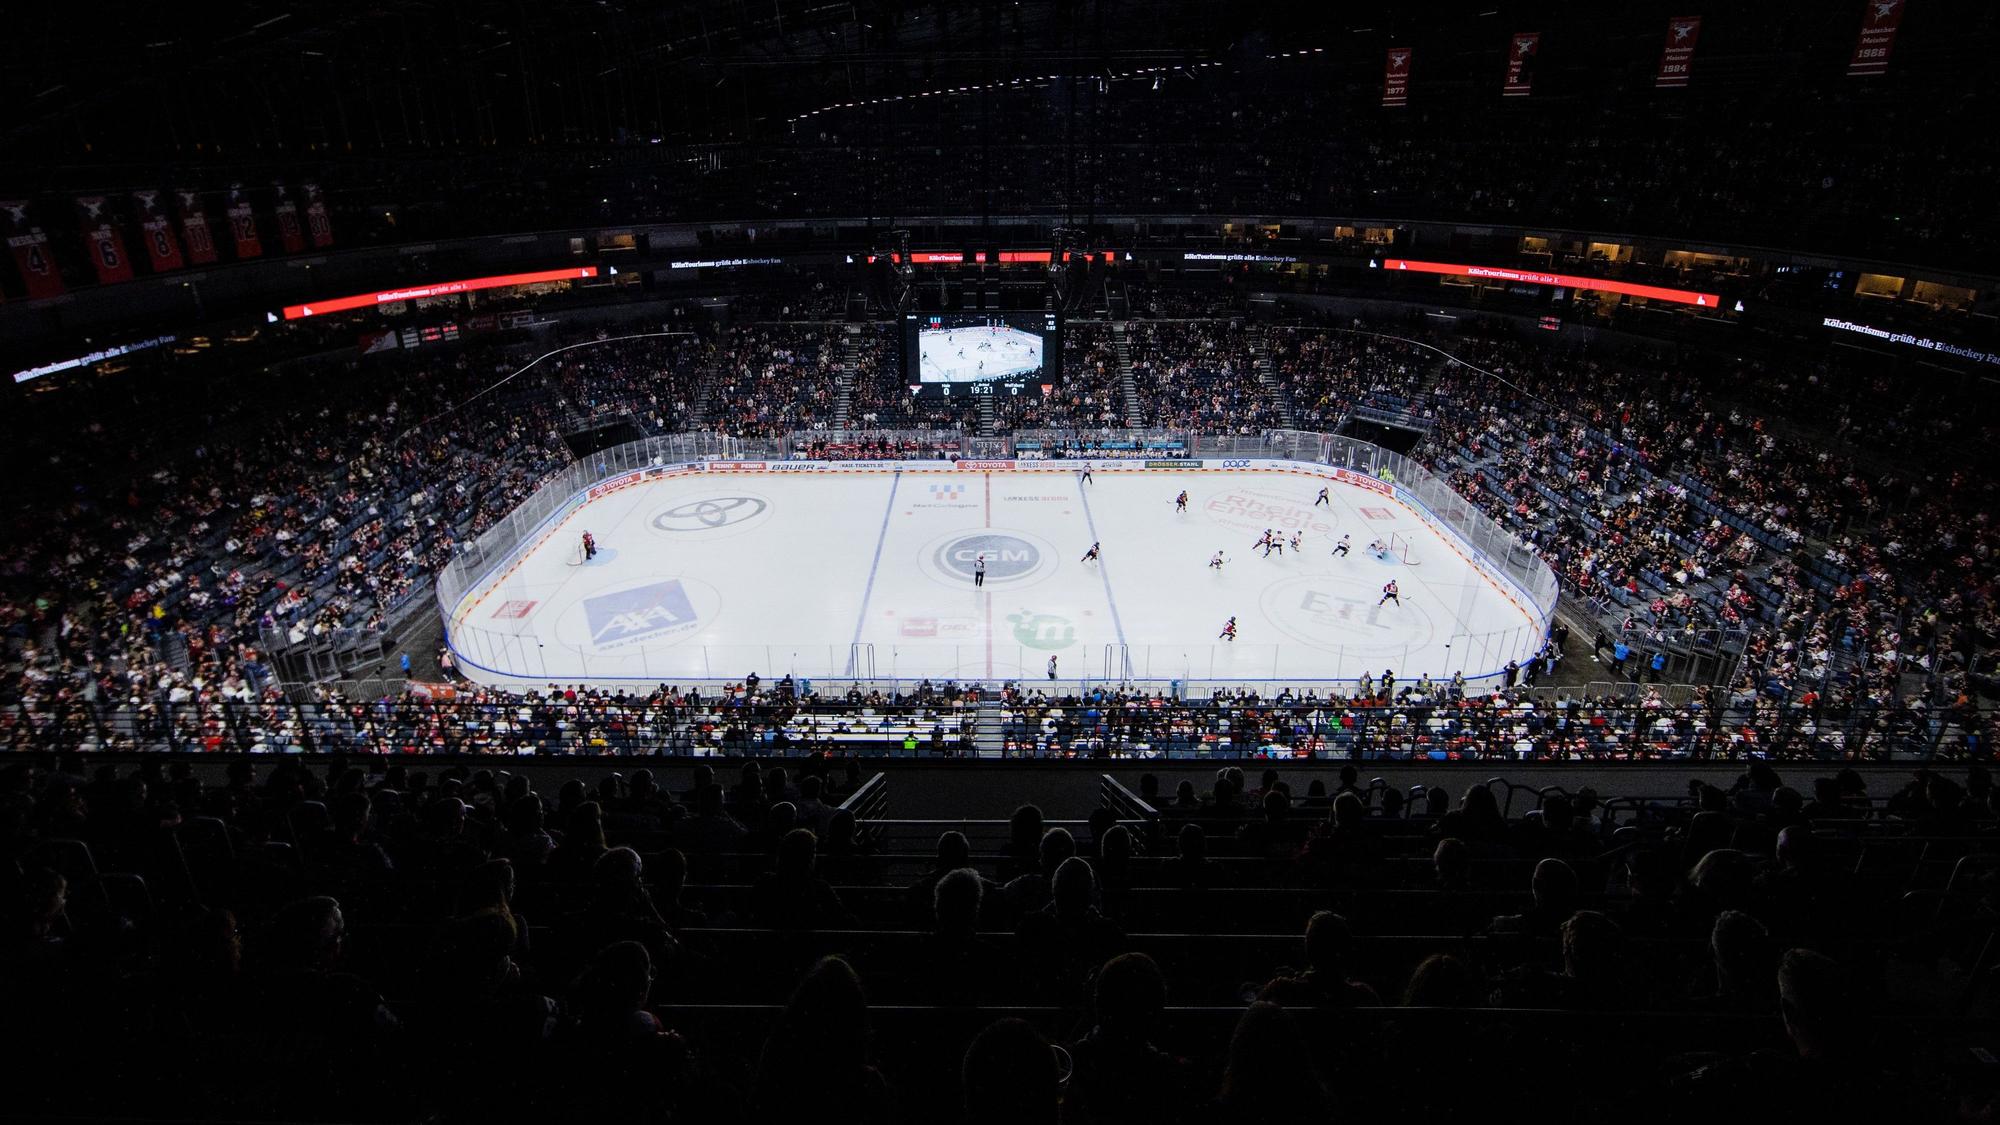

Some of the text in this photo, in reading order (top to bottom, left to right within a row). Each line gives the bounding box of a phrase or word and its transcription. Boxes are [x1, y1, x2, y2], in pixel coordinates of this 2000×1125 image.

[1663, 64, 1687, 73] 1984
[154, 230, 172, 258] 8
[27, 243, 49, 276] 4
[100, 240, 120, 269] 6
[671, 259, 715, 268] KölnTourismus
[732, 258, 742, 266] alle
[1468, 268, 1519, 279] KölnTourismus
[1519, 273, 1539, 282] grüßt
[1540, 275, 1553, 283] alle
[1823, 318, 1890, 339] KölnTourismus
[1890, 332, 1916, 345] grüßt
[1917, 338, 1934, 349] alle
[1935, 341, 1986, 362] Eishockey
[943, 387, 950, 395] 0
[970, 386, 993, 394] 19:21
[1011, 387, 1018, 395] 0
[607, 476, 633, 490] TOYOTA
[1358, 475, 1385, 491] TOYOTA
[1225, 495, 1313, 521] Rhein
[1207, 500, 1333, 533] Energie
[954, 550, 1030, 562] CGM
[1300, 590, 1392, 630] ETL
[593, 605, 679, 641] AXA
